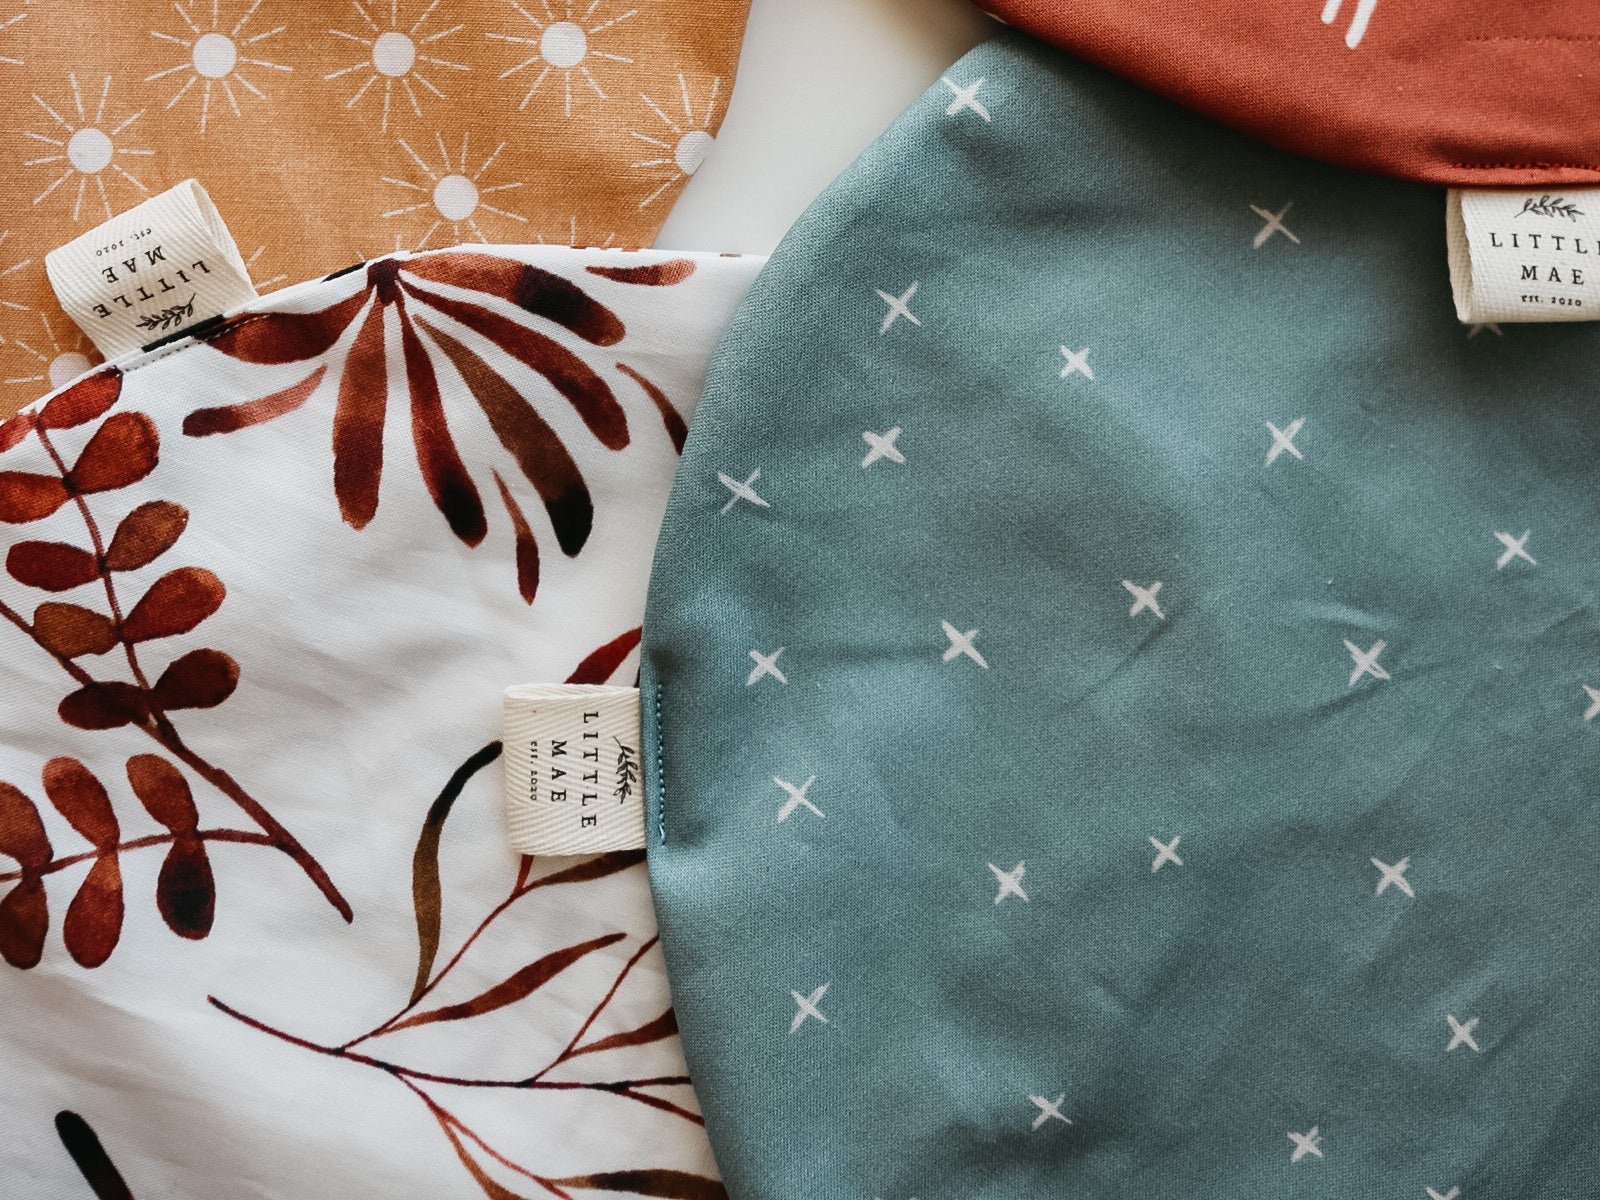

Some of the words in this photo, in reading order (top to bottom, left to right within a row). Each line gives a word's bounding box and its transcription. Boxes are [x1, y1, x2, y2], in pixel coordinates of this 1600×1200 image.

[130, 227, 152, 241] est.
[96, 240, 125, 257] 2020
[101, 245, 167, 284] MAE
[1521, 265, 1584, 285] MAE
[92, 260, 211, 319] LITTLE
[1521, 295, 1544, 303] est.
[1551, 296, 1582, 307] 2020
[530, 741, 538, 764] est.
[550, 740, 567, 802] MAE
[581, 711, 599, 828] LITTLE
[530, 770, 538, 801] 2020
